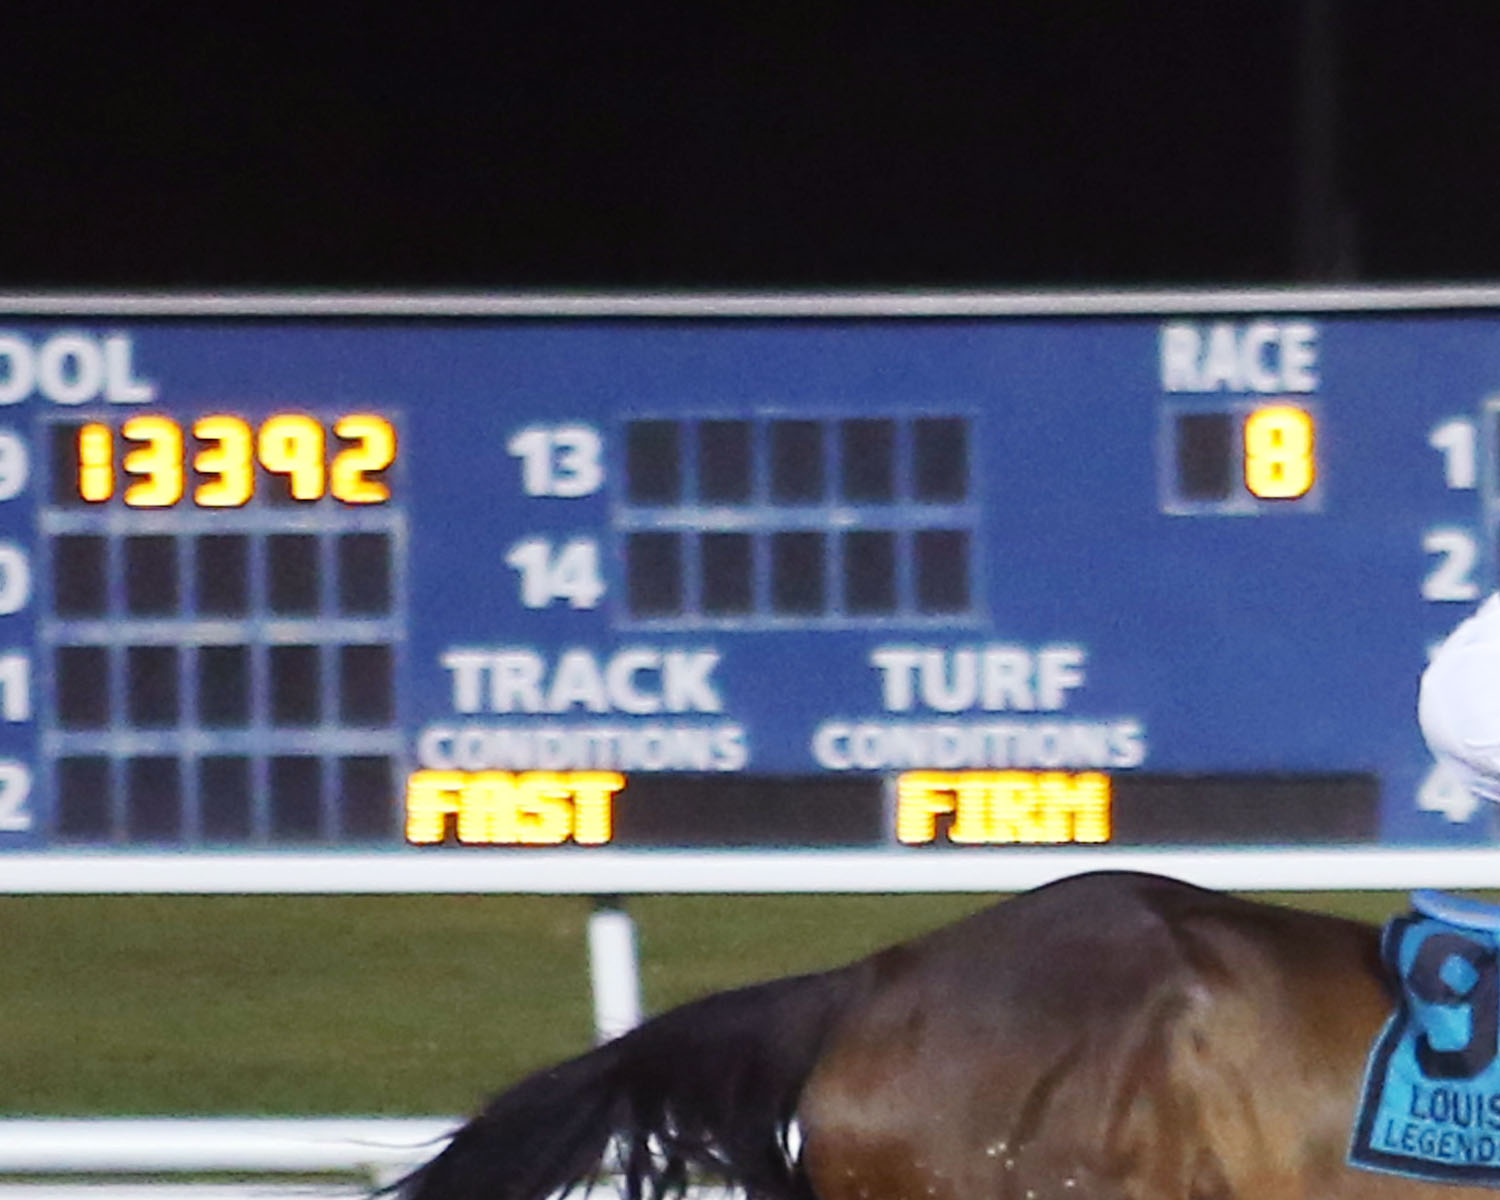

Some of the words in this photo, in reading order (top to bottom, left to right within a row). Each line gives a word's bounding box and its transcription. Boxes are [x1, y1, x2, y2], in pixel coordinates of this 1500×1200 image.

[1160, 324, 1320, 394] RACE
[77, 414, 397, 507] 13392
[508, 428, 604, 498] 13
[1243, 404, 1316, 500] 8
[1430, 420, 1476, 490] 1
[508, 540, 604, 608] 14
[1422, 530, 1479, 601] 2
[442, 649, 722, 714] TRACK
[870, 646, 1086, 713] TURF
[417, 725, 748, 771] CONDITIONS
[812, 720, 1148, 769] CONDITIONS
[404, 769, 626, 846] FAST
[894, 769, 1113, 846] FIRM
[1406, 931, 1500, 1080] 9
